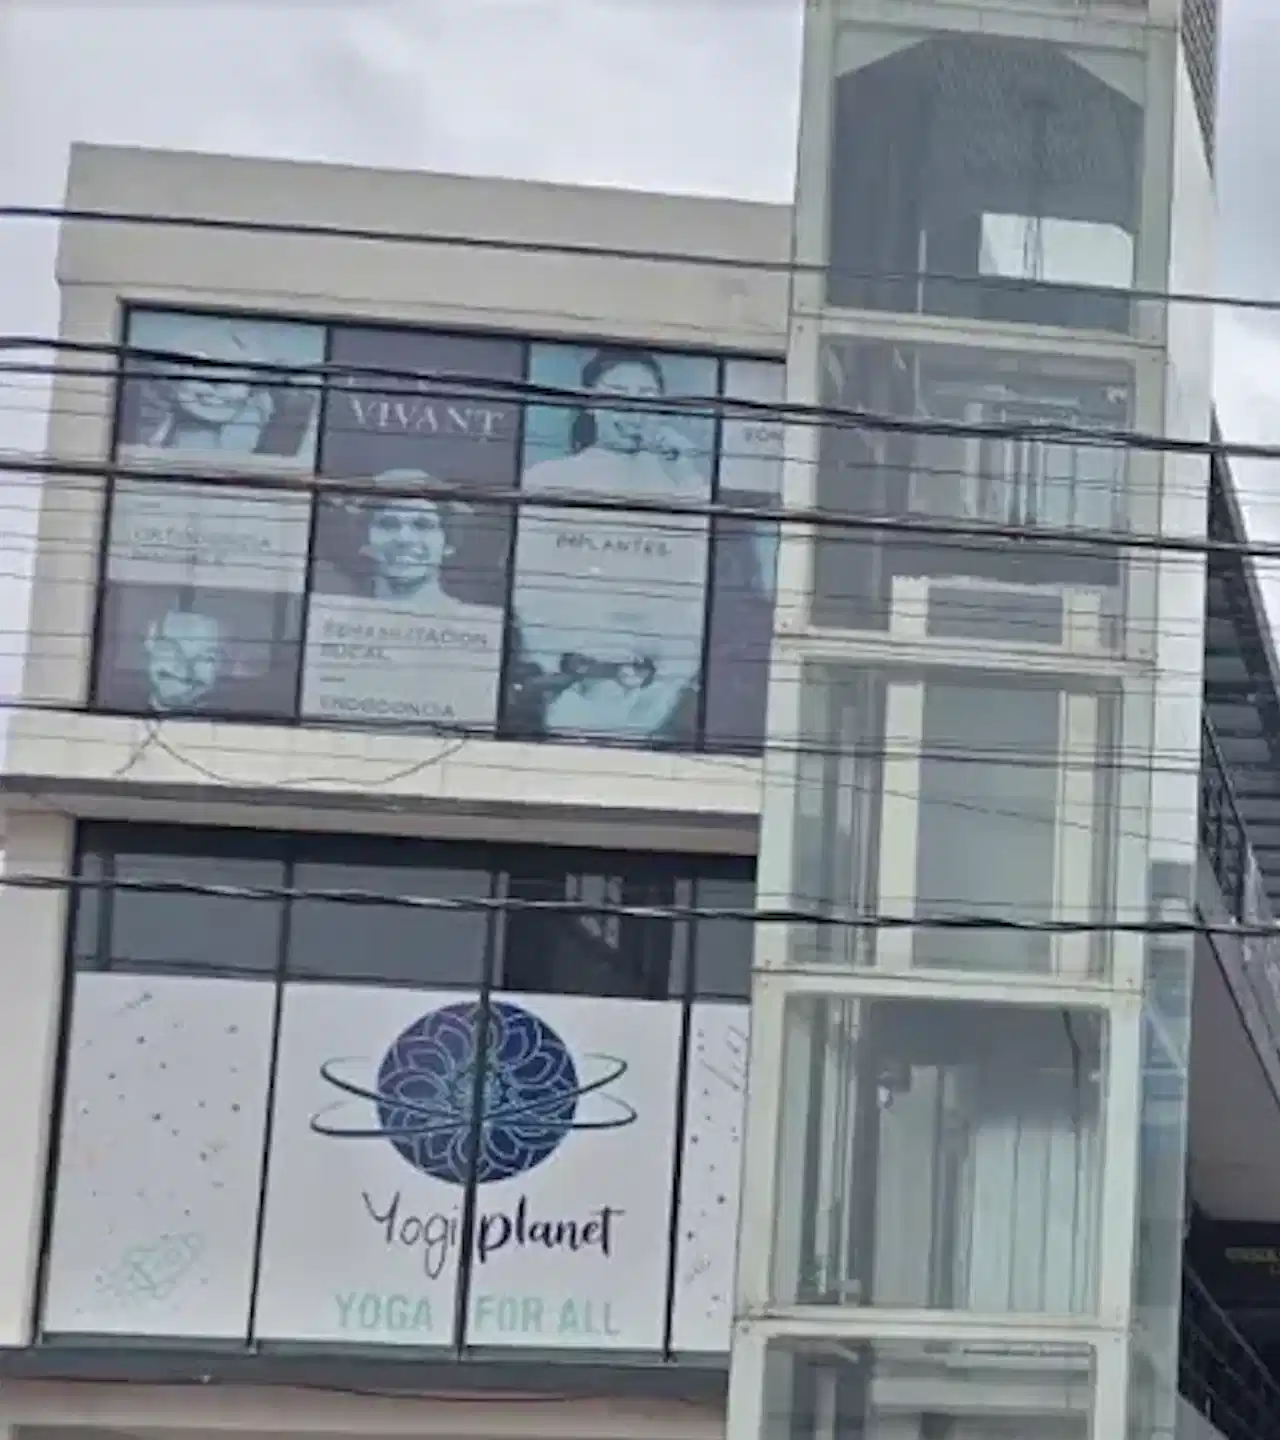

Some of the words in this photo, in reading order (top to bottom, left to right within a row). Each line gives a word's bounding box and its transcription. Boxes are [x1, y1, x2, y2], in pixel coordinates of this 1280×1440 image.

[347, 396, 505, 437] VIVANT
[361, 1190, 459, 1281] Yogi
[477, 1192, 627, 1265] planet
[335, 1291, 435, 1332] YOGA
[473, 1295, 545, 1334] FOR
[557, 1297, 621, 1337] ALL
